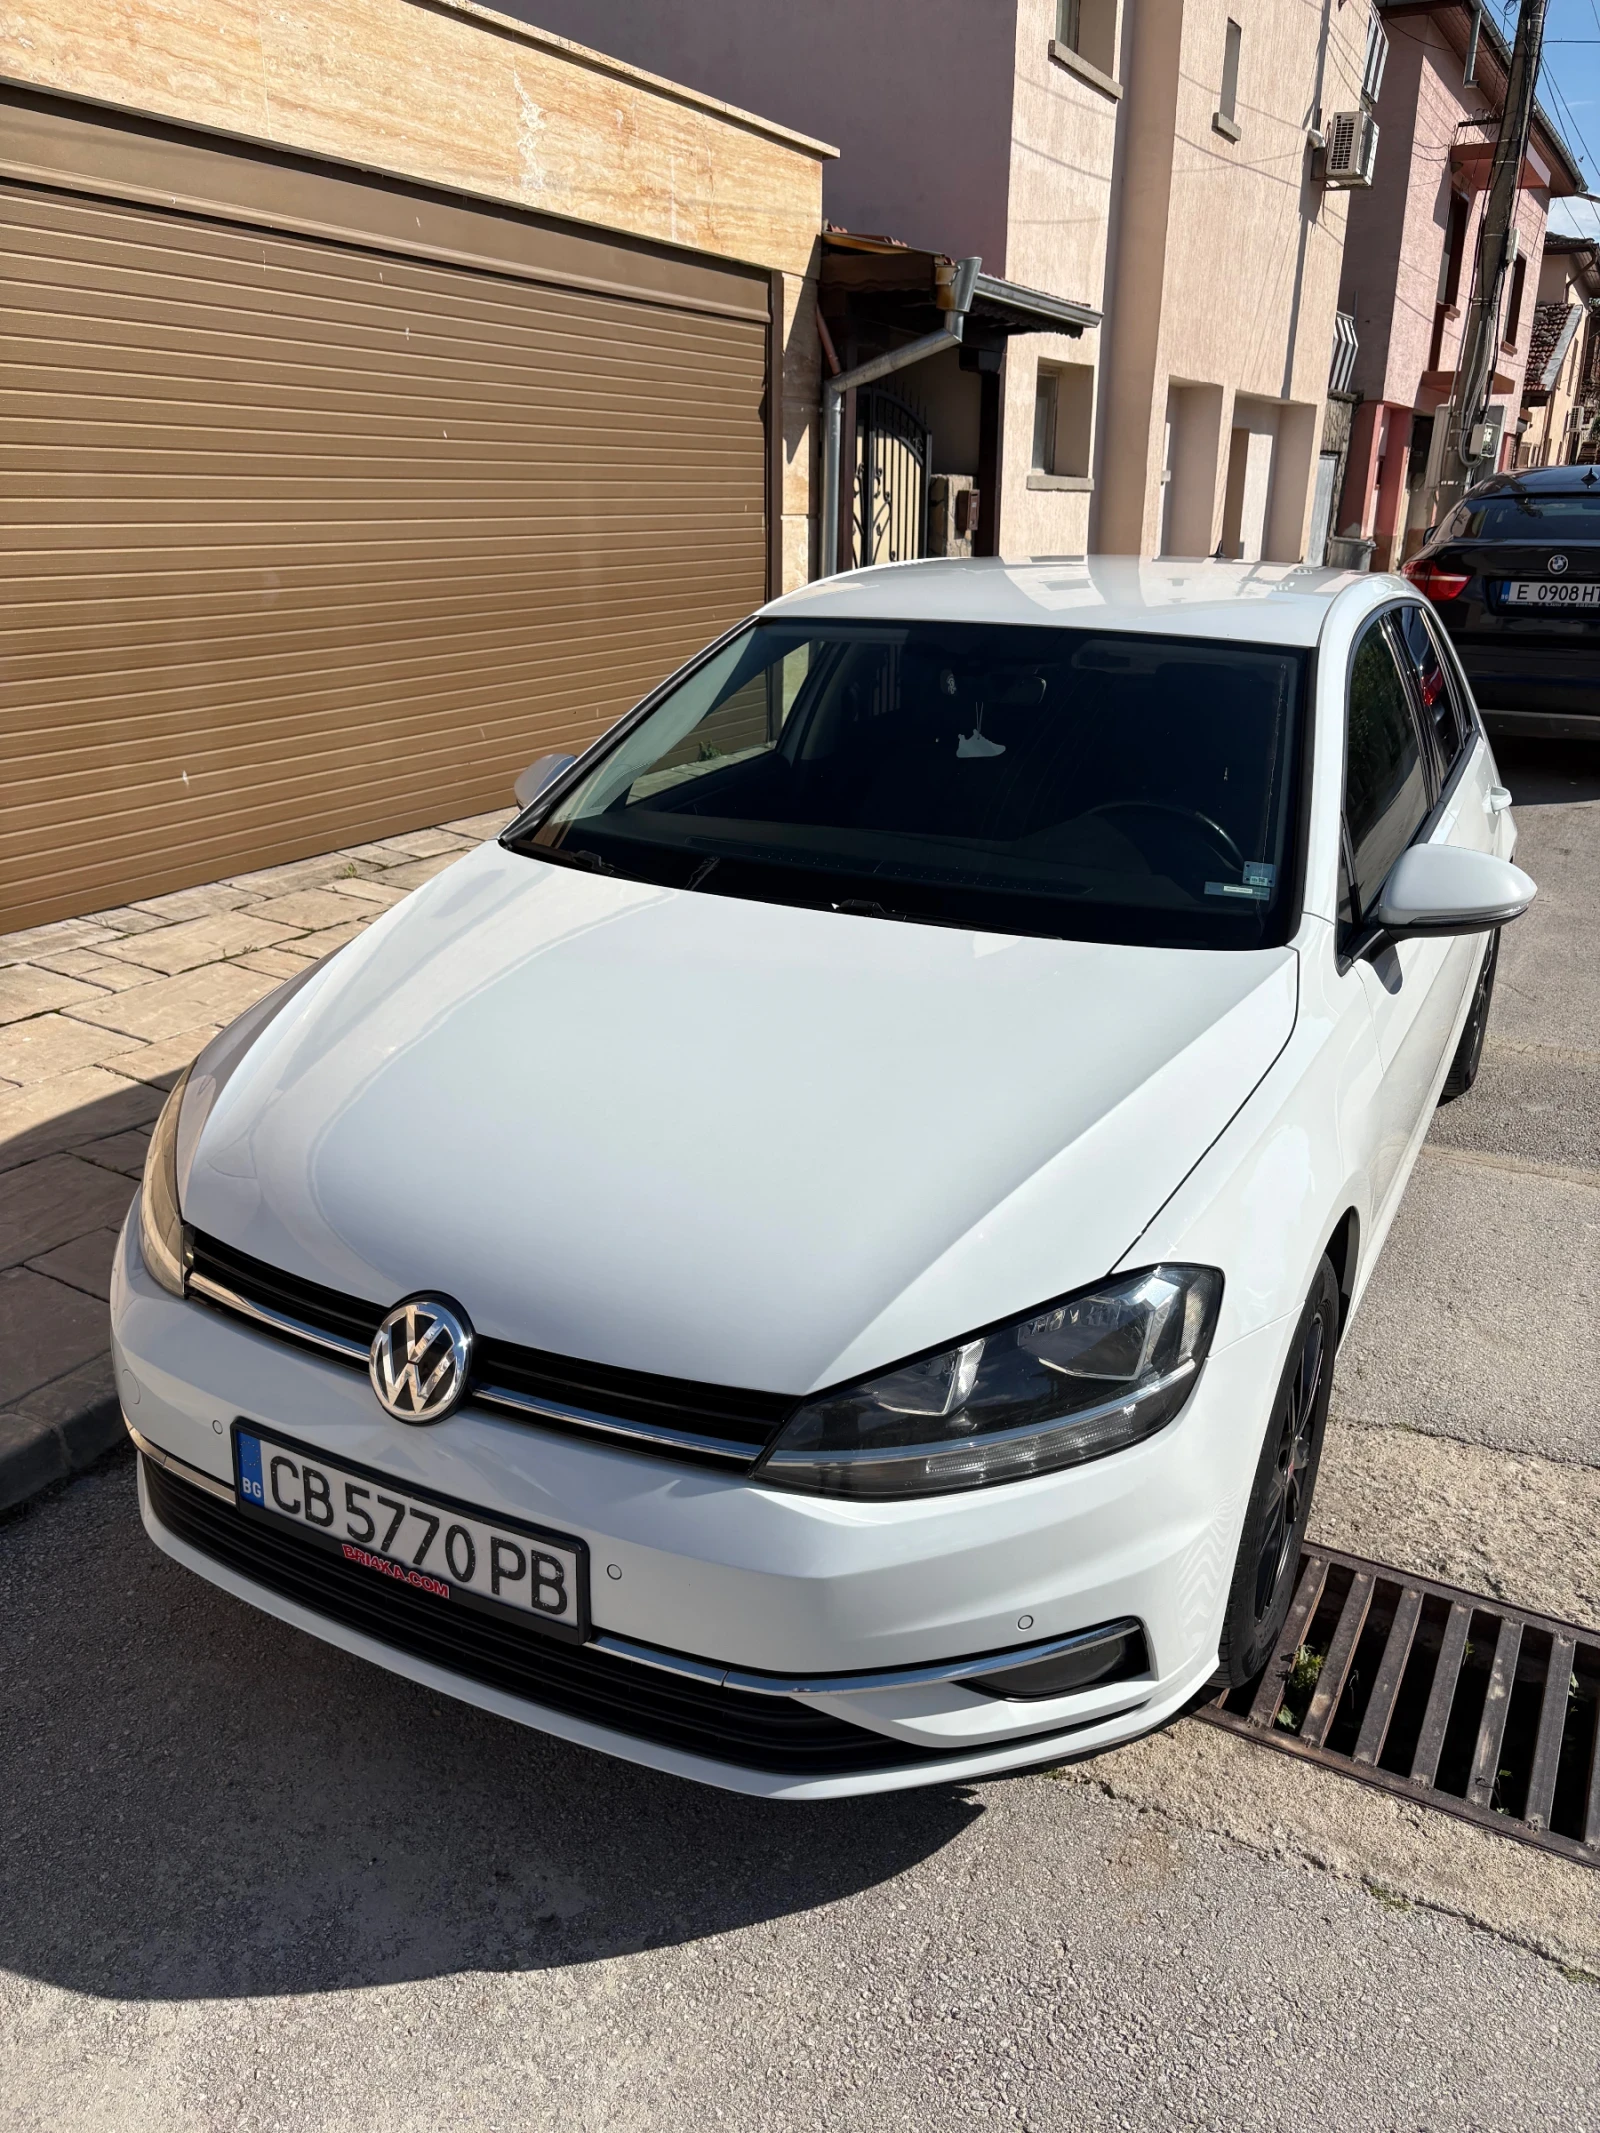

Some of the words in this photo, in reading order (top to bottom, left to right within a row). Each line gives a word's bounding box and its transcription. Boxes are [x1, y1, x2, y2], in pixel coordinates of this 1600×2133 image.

[1516, 584, 1529, 600] E
[1538, 585, 1580, 601] 0908
[242, 1477, 262, 1498] BG
[345, 1483, 477, 1583] 5770
